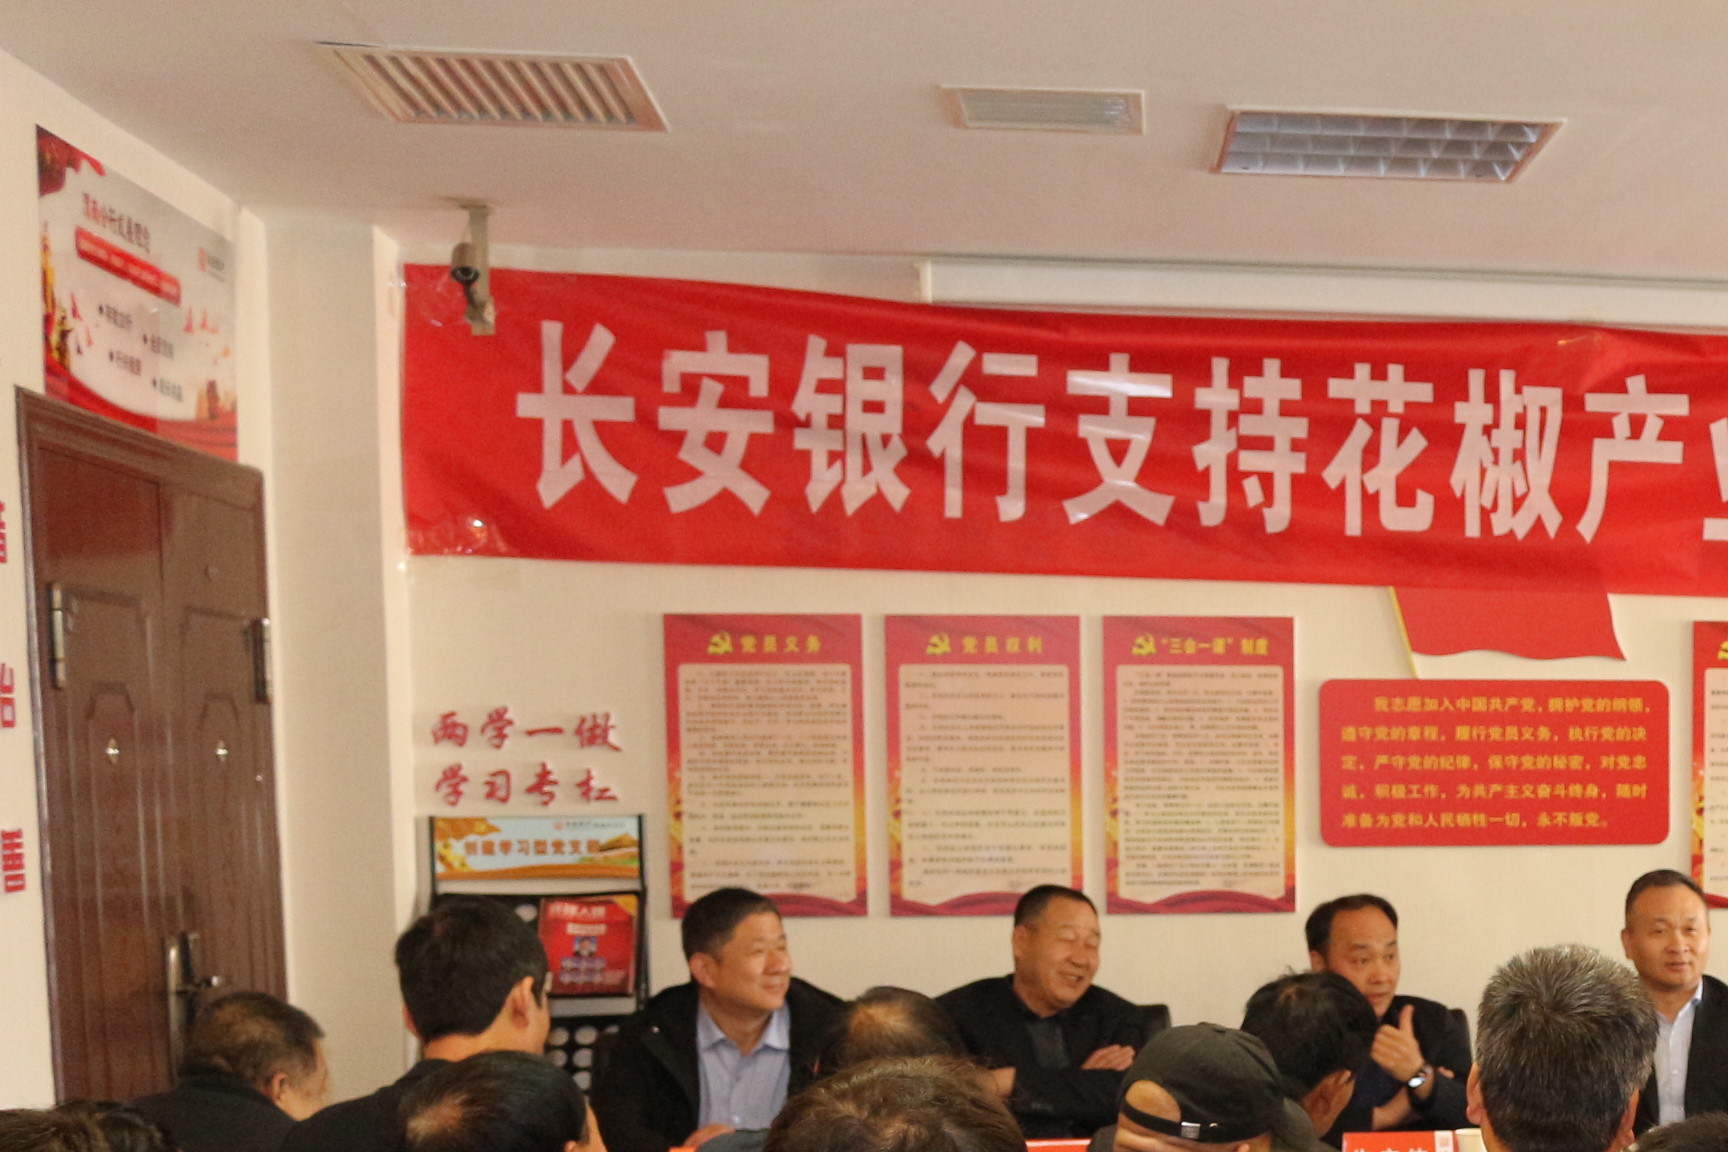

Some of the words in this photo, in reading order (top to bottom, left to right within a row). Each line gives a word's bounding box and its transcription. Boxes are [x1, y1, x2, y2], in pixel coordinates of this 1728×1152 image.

[741, 635, 821, 653] 党员义务
[962, 635, 1044, 654] 党员权利
[432, 706, 622, 752] 两学一做
